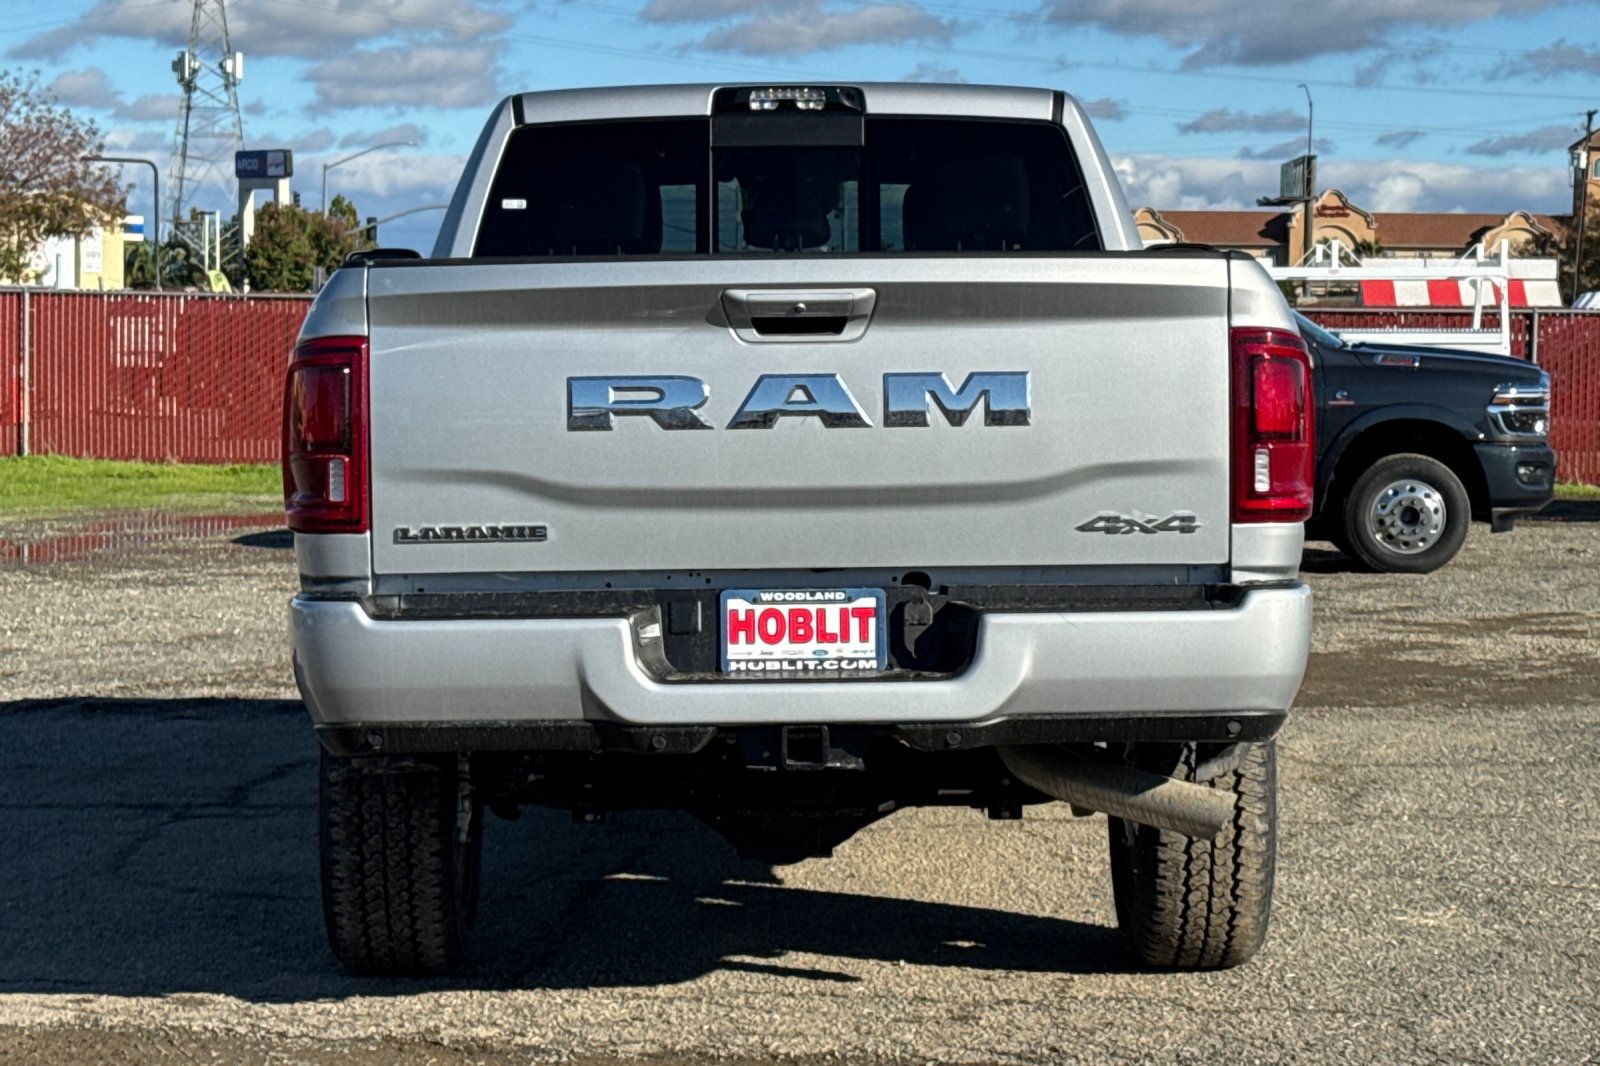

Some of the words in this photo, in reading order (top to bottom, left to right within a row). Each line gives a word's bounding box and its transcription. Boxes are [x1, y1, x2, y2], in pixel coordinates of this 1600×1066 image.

[566, 371, 1031, 431] RAM
[393, 525, 548, 544] LARAMIE
[760, 592, 846, 601] WOODLAND
[728, 607, 876, 645] HOBLIT
